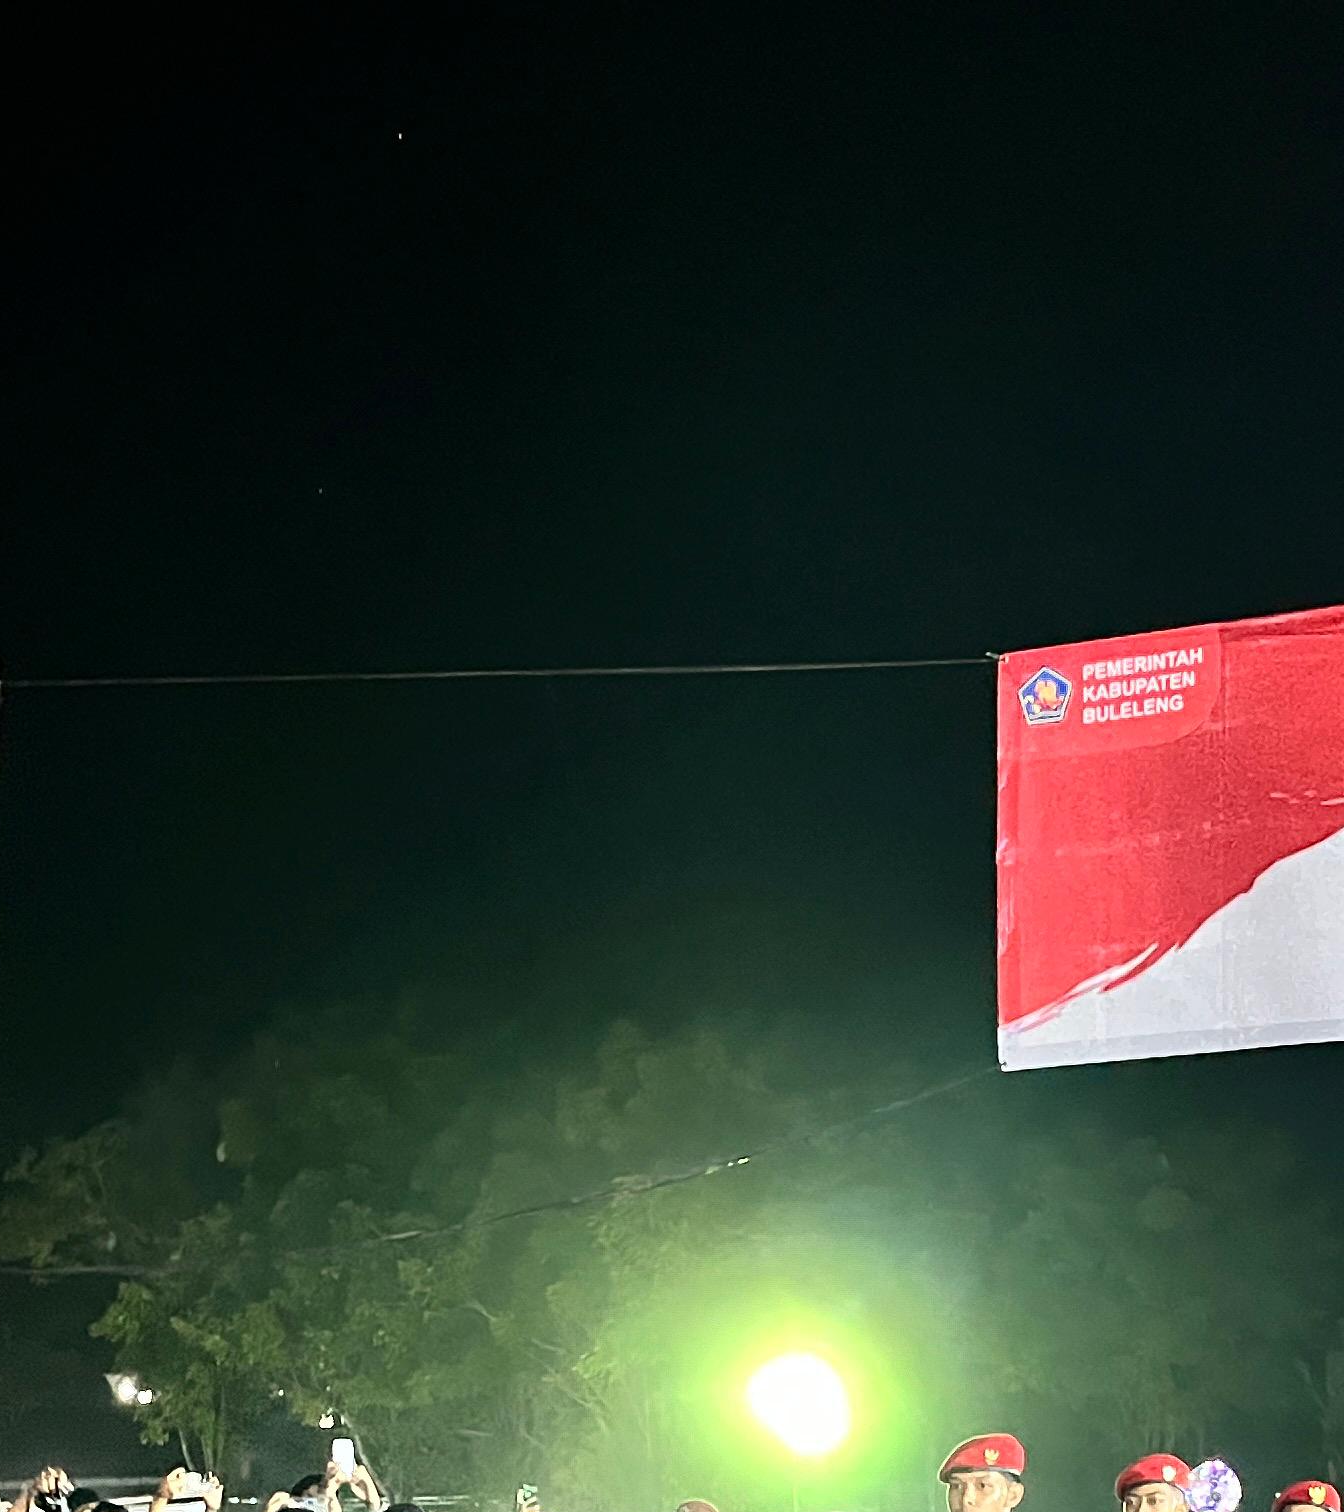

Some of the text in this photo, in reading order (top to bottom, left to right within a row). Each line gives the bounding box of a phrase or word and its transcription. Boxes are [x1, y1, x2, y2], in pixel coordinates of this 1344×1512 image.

[1082, 648, 1204, 682] PEMERINTAH
[1082, 671, 1195, 704] KABUPATEN
[1082, 694, 1185, 725] BULELENG
